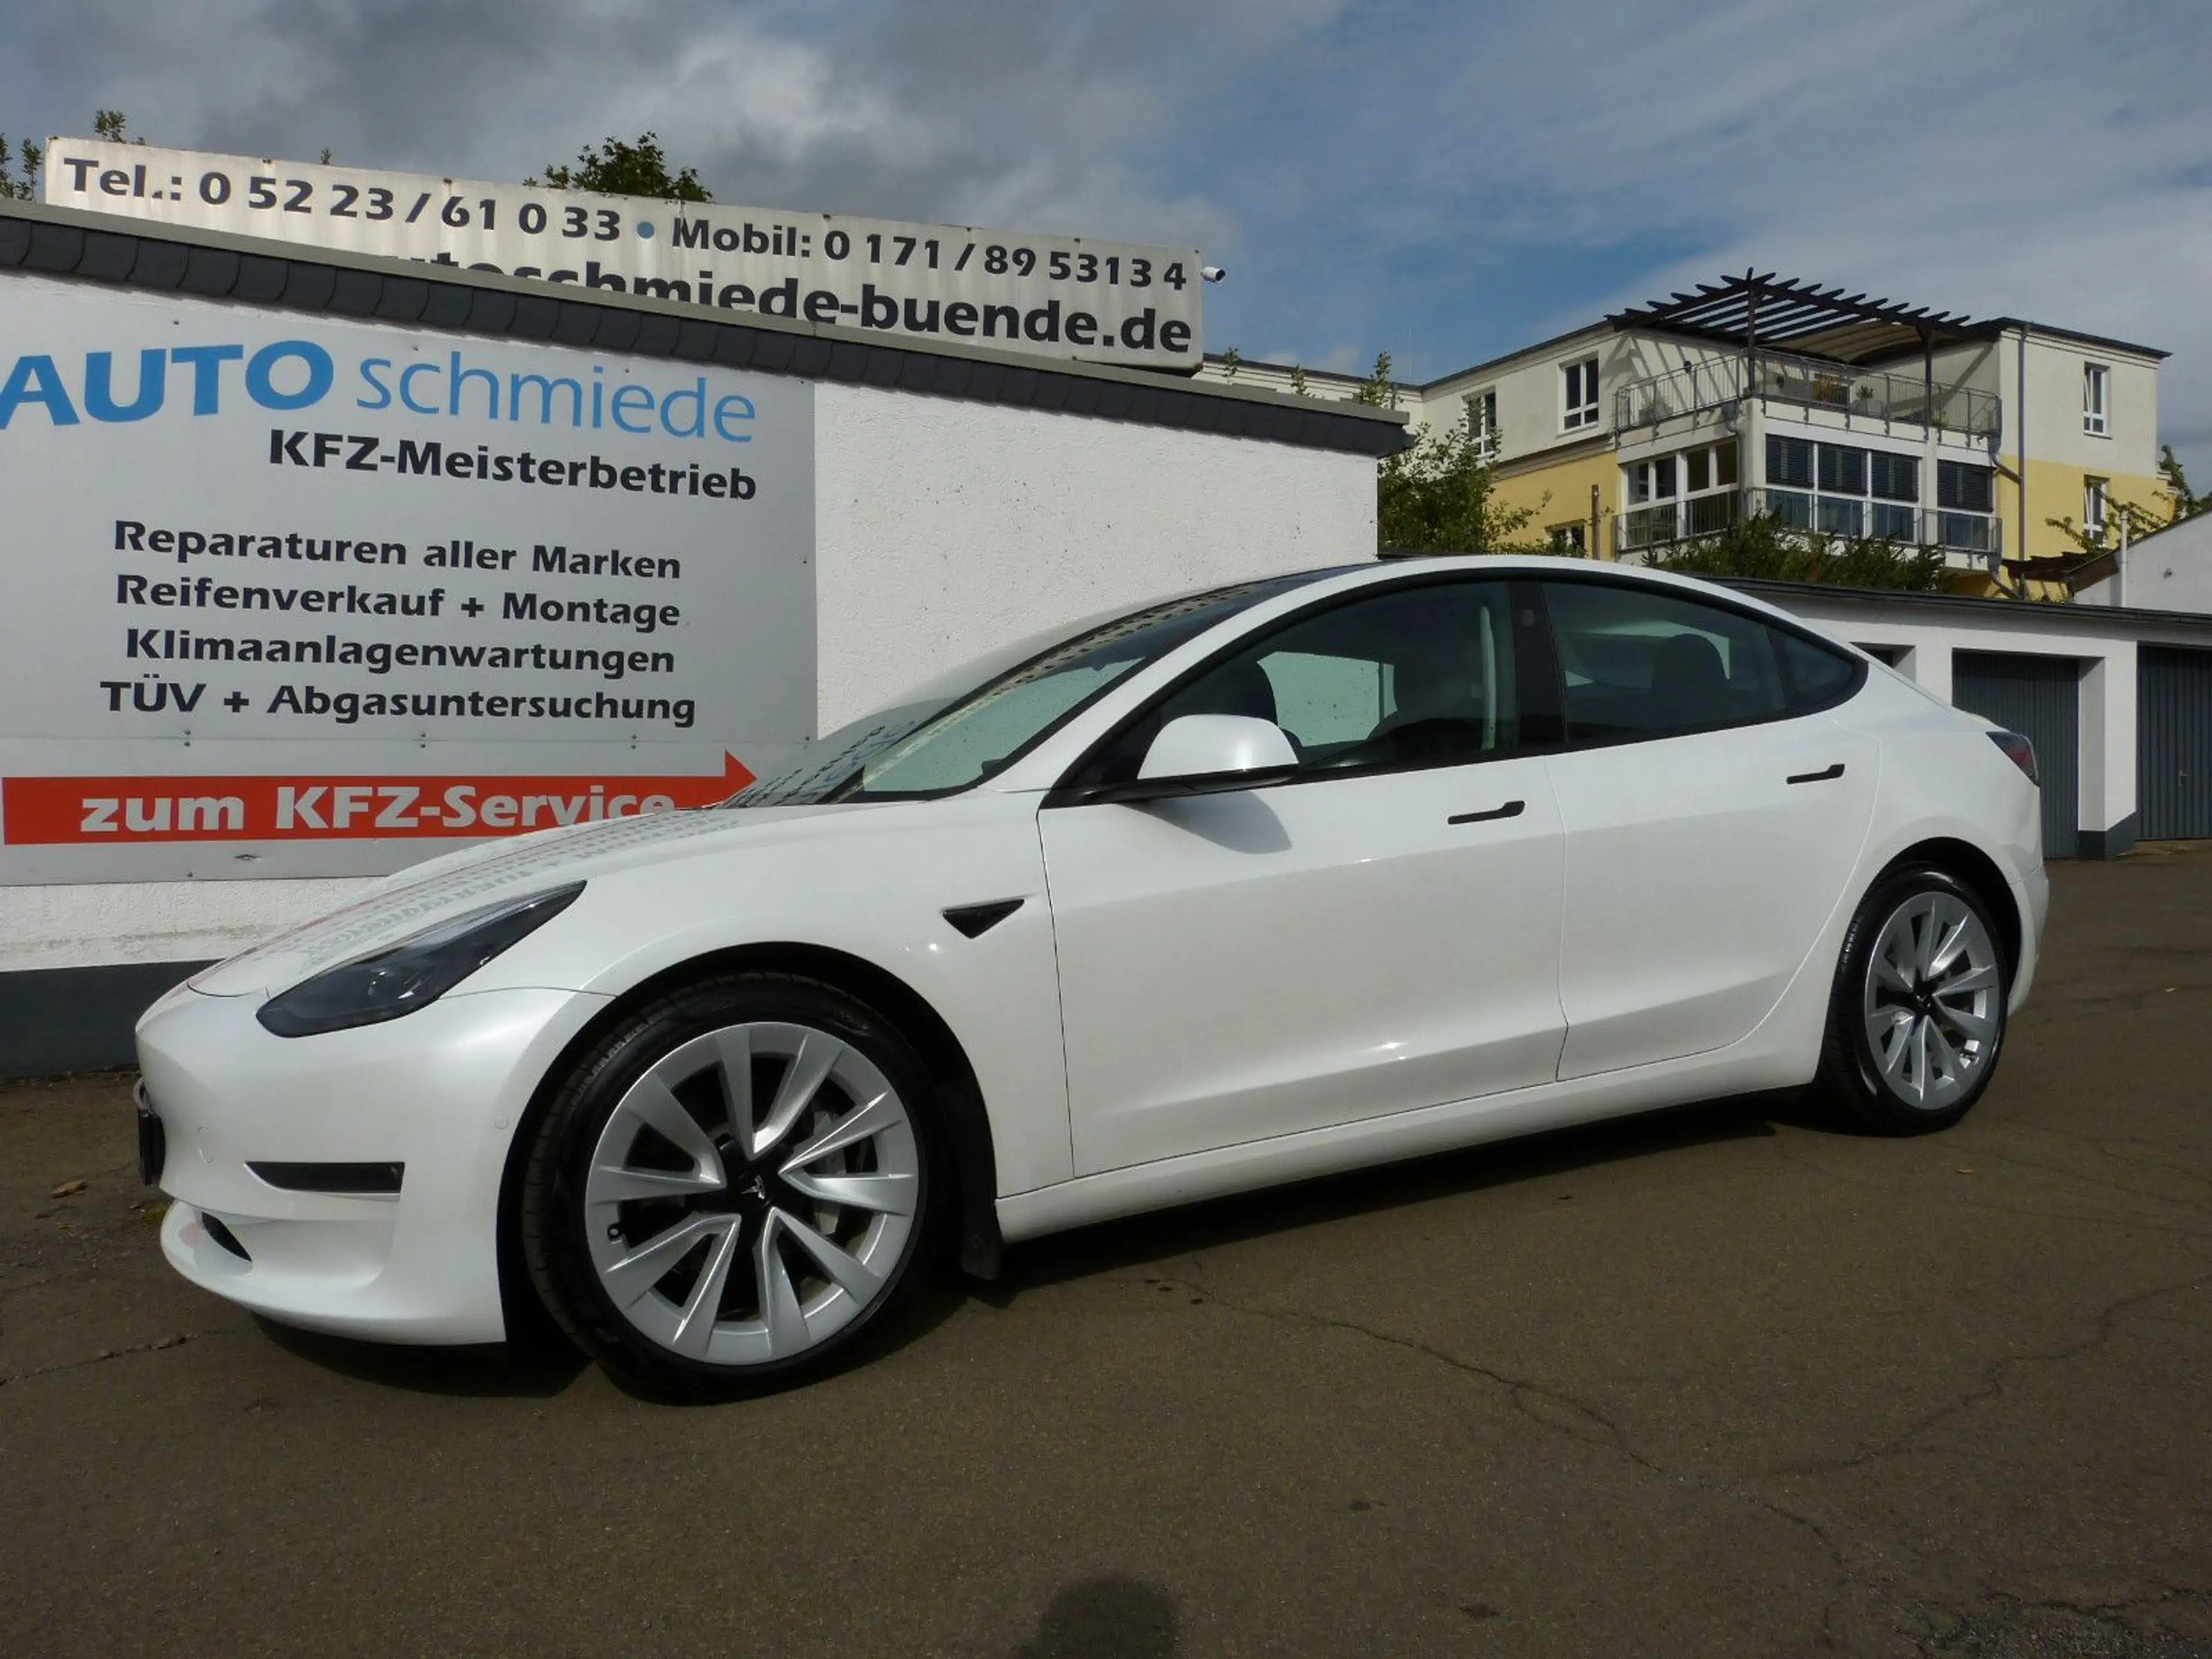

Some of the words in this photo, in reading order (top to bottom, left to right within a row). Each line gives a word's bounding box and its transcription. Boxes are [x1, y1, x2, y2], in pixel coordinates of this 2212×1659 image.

[64, 158, 181, 200] Tel.:
[672, 217, 810, 258] Mobil:
[0, 340, 334, 430] AUTO
[357, 352, 756, 443] schmiede
[270, 429, 756, 500] KFZ-Meisterbetrieb
[115, 520, 407, 565] Reparaturen
[423, 540, 517, 570] aller
[532, 545, 680, 579] Marken
[117, 574, 445, 616] Reifenverkauf
[461, 597, 484, 618] +
[502, 592, 680, 634] Montage
[127, 628, 674, 680] Klimaanlagenwartungen
[100, 673, 207, 713] TÜV
[224, 691, 249, 713] +
[266, 685, 695, 728] Abgasuntersuchung
[81, 797, 244, 832] zum
[276, 785, 675, 828] KFZ-Service
